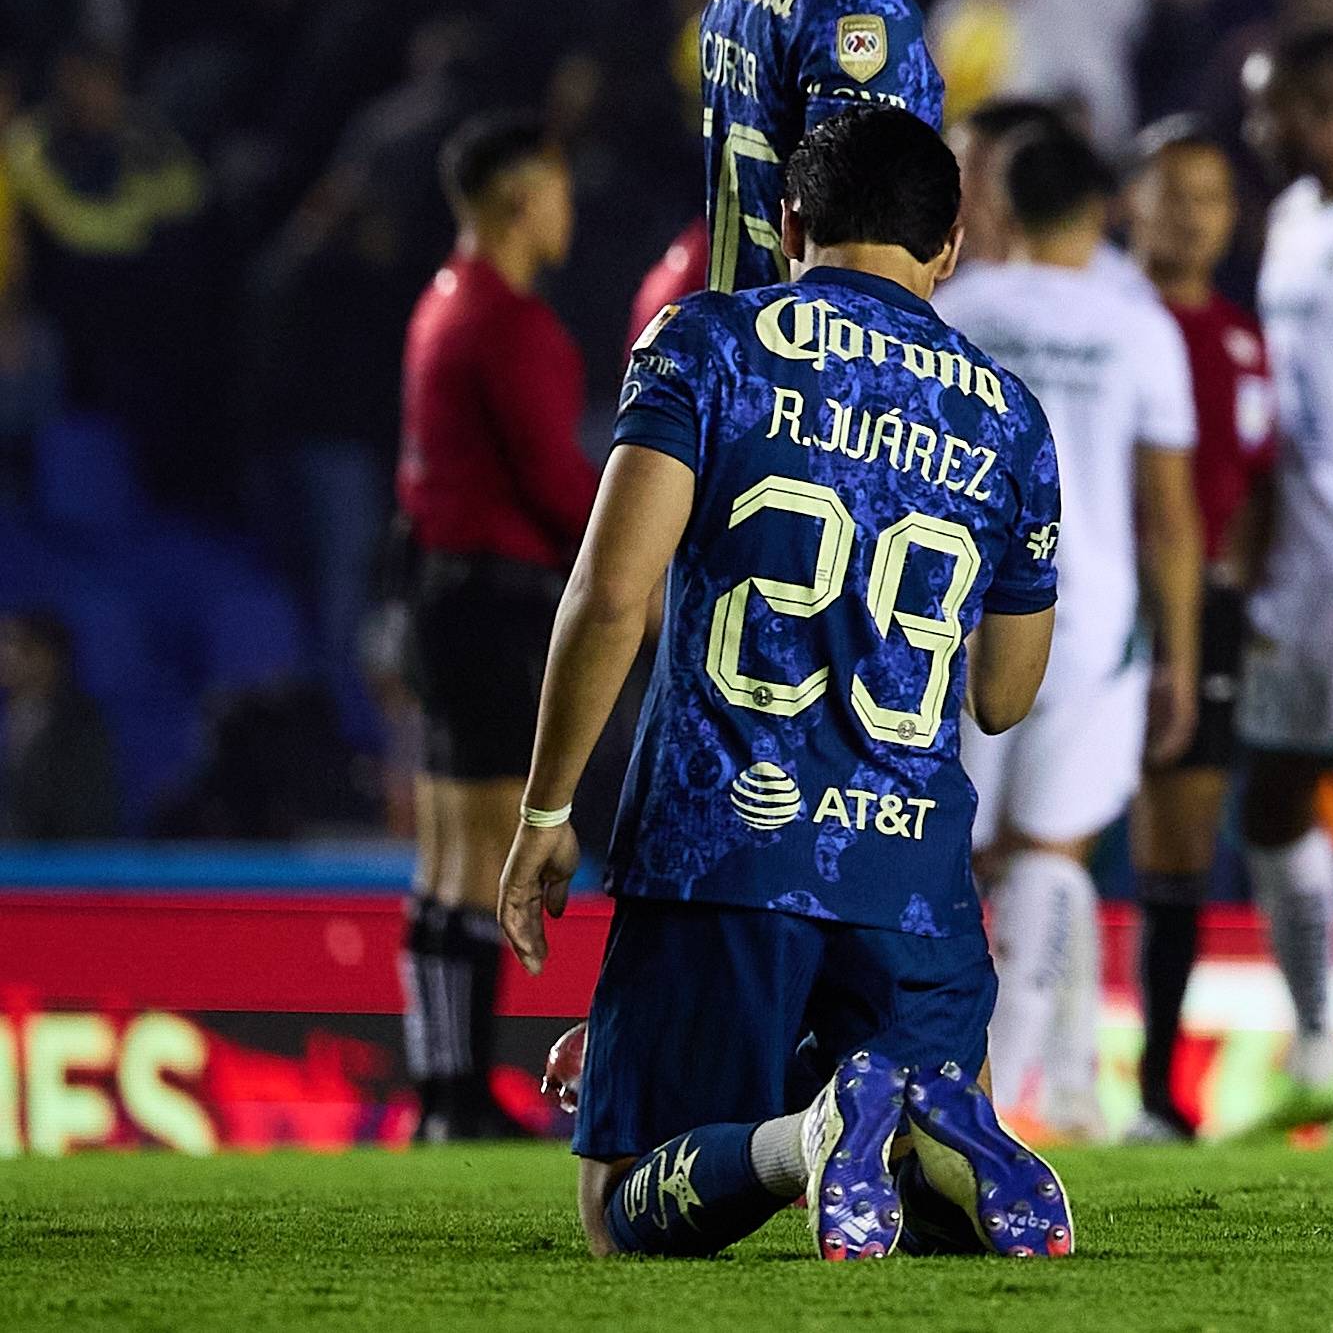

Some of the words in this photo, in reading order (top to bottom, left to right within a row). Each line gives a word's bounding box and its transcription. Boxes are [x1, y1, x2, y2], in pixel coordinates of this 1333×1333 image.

[755, 296, 1009, 415] Corona
[766, 387, 998, 501] R.JUÁREZ
[706, 475, 982, 749] 29
[812, 787, 936, 840] AT&T
[0, 1011, 217, 1156] ES
